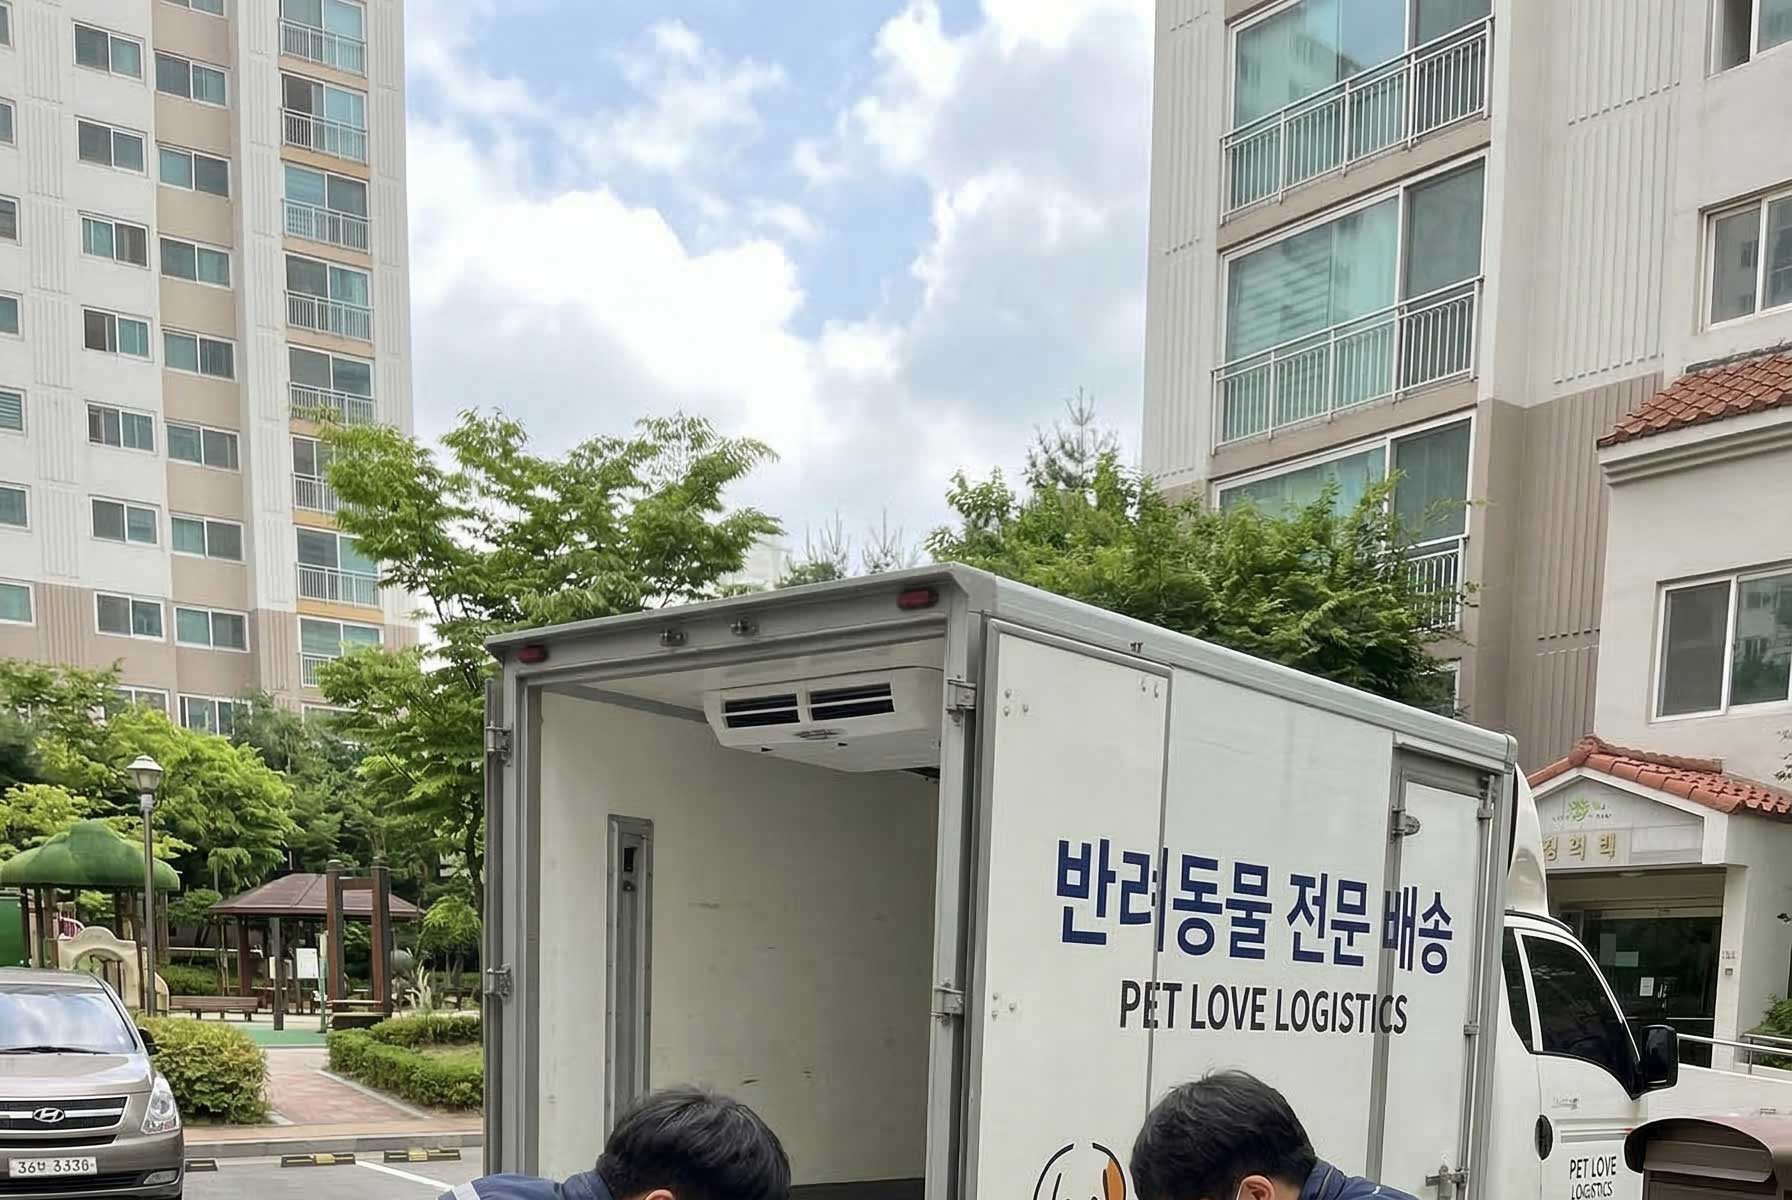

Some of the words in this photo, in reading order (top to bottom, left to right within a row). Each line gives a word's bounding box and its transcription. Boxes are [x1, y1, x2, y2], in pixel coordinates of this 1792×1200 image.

[1057, 838, 1272, 960] 반려동물
[1287, 873, 1370, 967] 전문
[1384, 886, 1452, 974] 배송
[1120, 980, 1181, 1028] PET
[1191, 983, 1267, 1030] LOVE
[1275, 988, 1408, 1034] LOGISTICS
[1569, 1158, 1589, 1180] PET
[1591, 1156, 1617, 1178] LOVE
